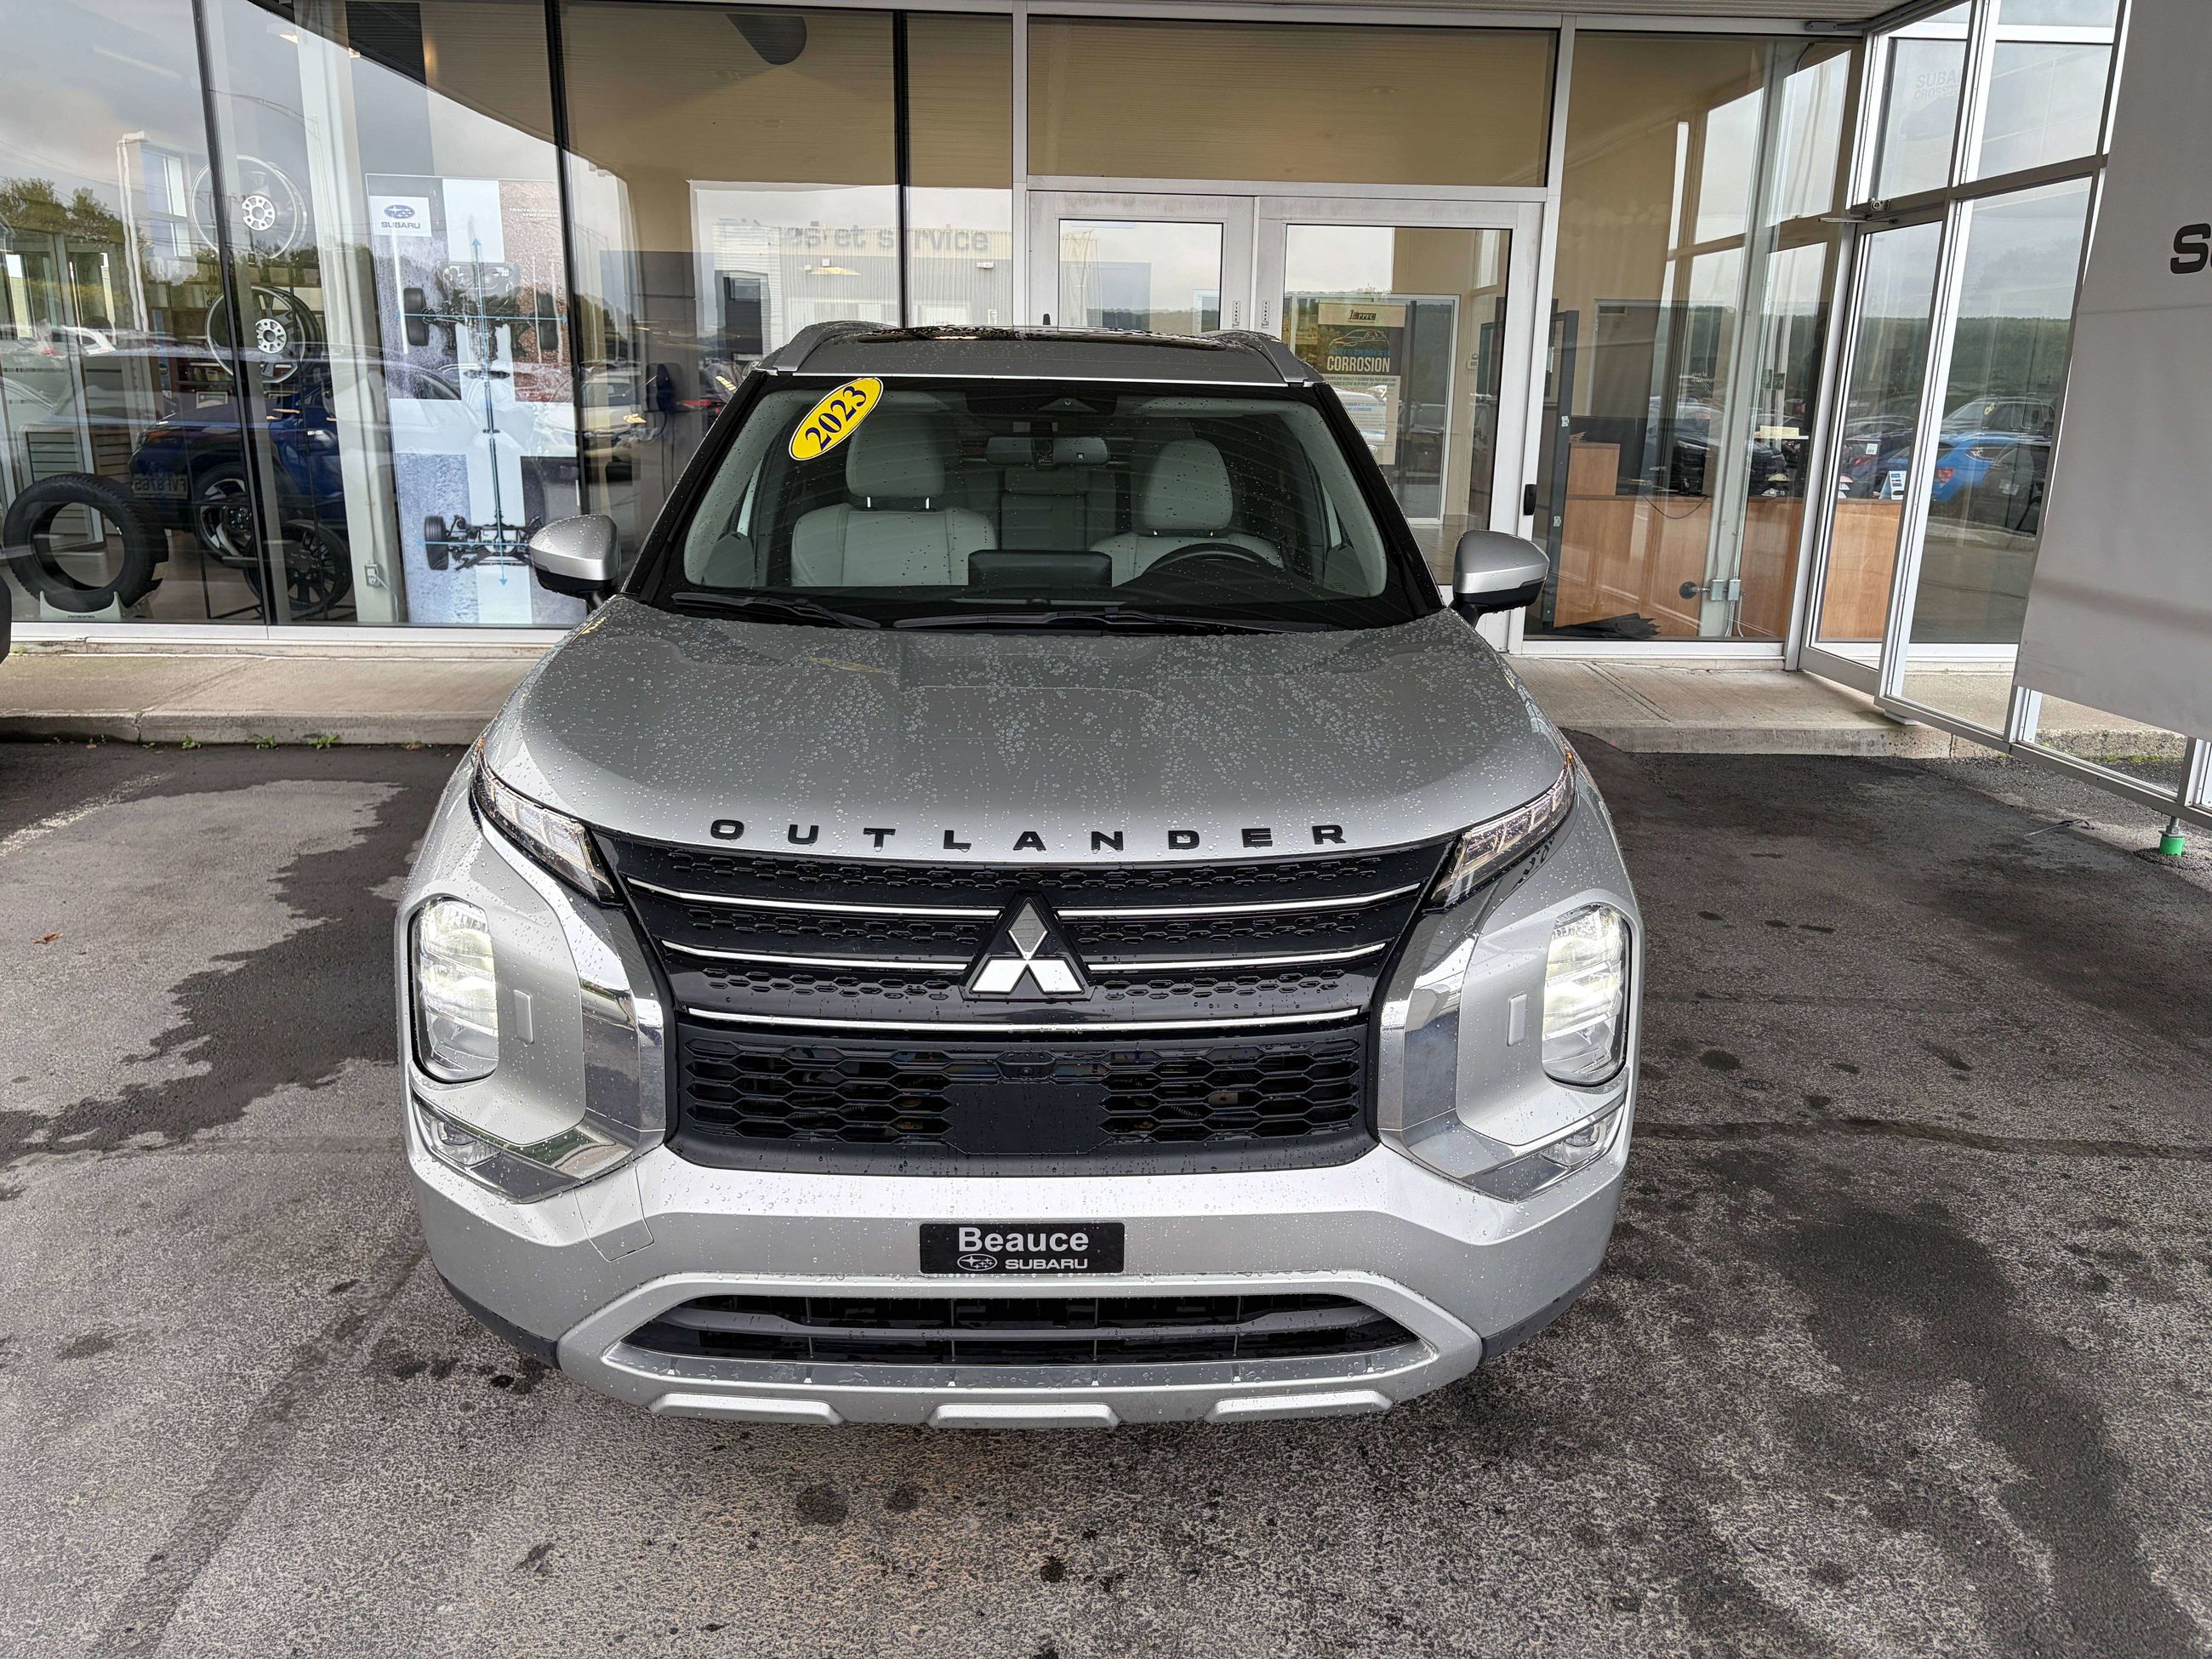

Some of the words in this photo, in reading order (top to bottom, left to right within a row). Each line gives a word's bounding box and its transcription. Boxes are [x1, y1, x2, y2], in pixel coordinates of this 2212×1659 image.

[878, 224, 989, 252] srvice
[2170, 223, 2212, 274] S
[1327, 356, 1390, 372] CORROSION
[805, 386, 867, 451] 2023
[710, 819, 1347, 852] OUTLANDER
[958, 1227, 1089, 1252] Beauce
[1005, 1258, 1088, 1269] SUBARU
